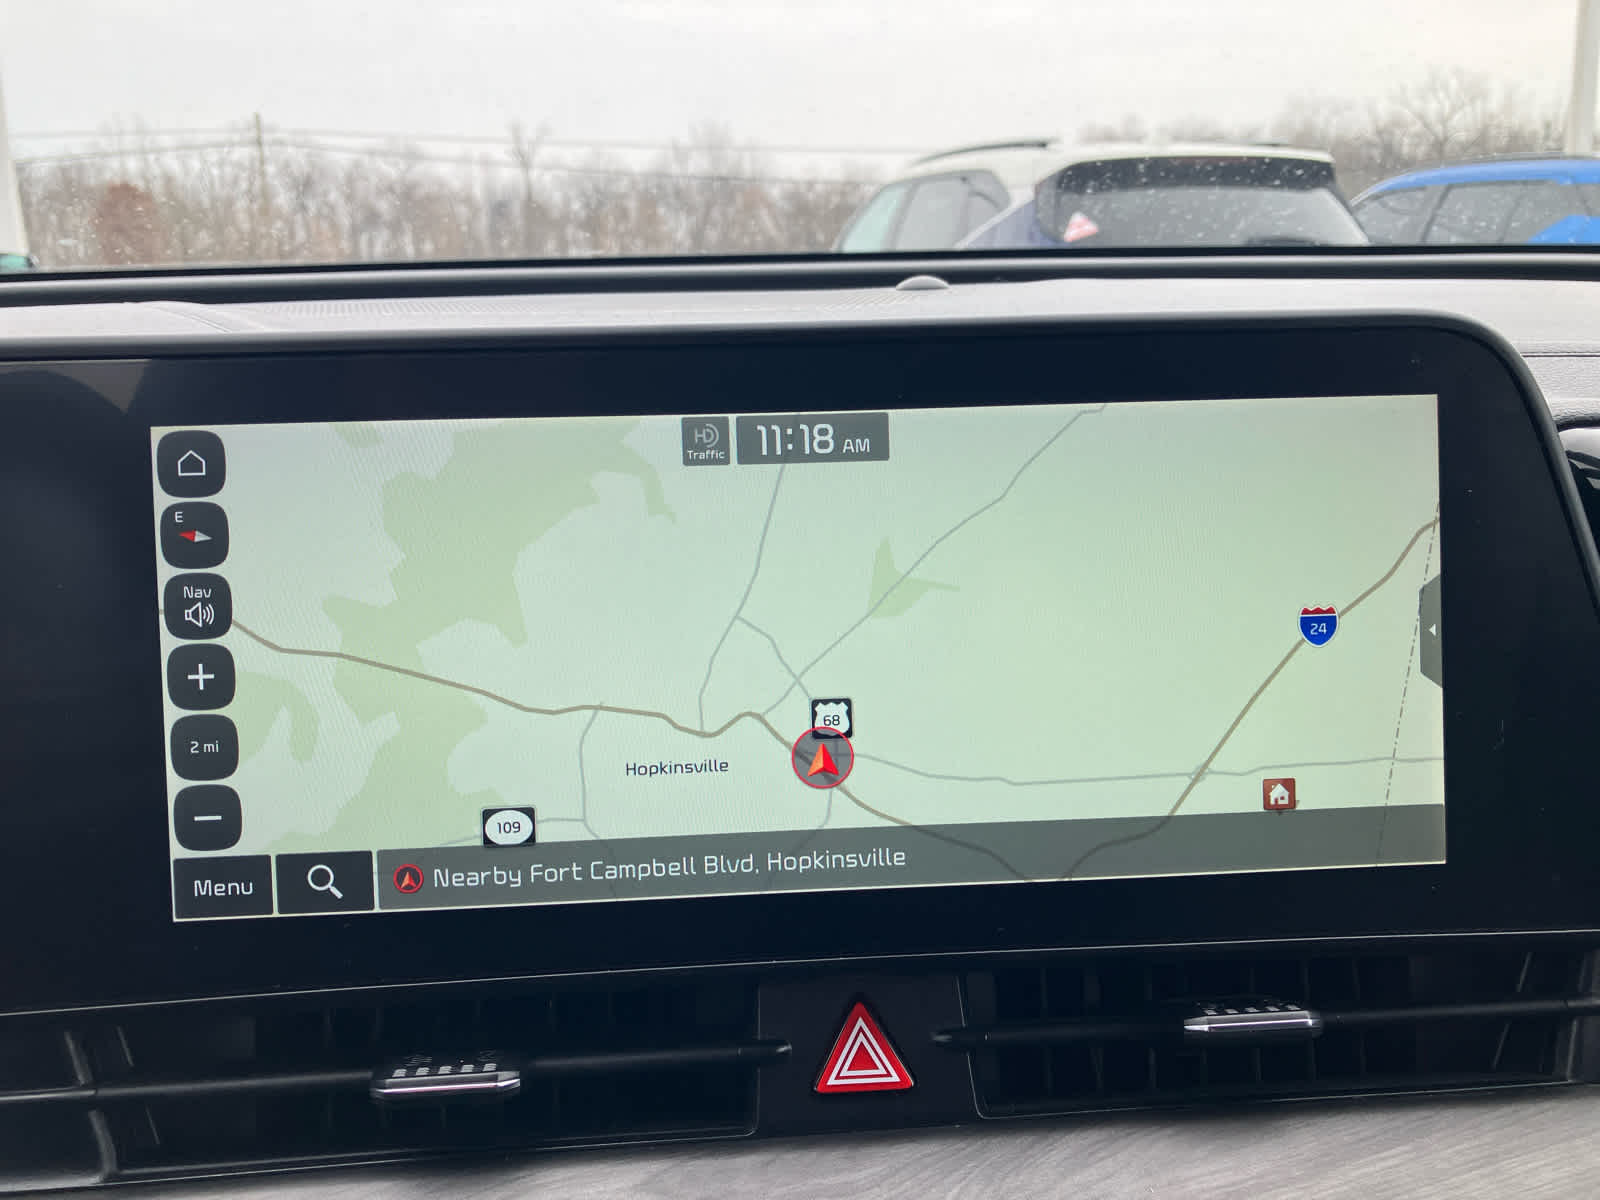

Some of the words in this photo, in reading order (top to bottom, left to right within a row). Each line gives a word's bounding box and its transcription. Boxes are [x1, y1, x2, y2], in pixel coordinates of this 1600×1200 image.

[756, 423, 835, 456] 11:18
[842, 438, 871, 454] AM
[687, 449, 725, 461] Traffic
[174, 511, 184, 523] E
[183, 586, 212, 599] Nav
[1310, 622, 1328, 636] 24
[822, 714, 841, 727] 68
[190, 741, 199, 754] 2
[203, 740, 219, 753] mi
[625, 759, 729, 778] Hopkinsville
[496, 821, 521, 834] 109
[433, 865, 522, 888] Nearby
[530, 863, 583, 884] Fort
[590, 857, 697, 881] Campbell
[703, 852, 760, 875] Blvd,
[767, 847, 907, 874] Hopkinsville
[193, 879, 254, 897] Menu
